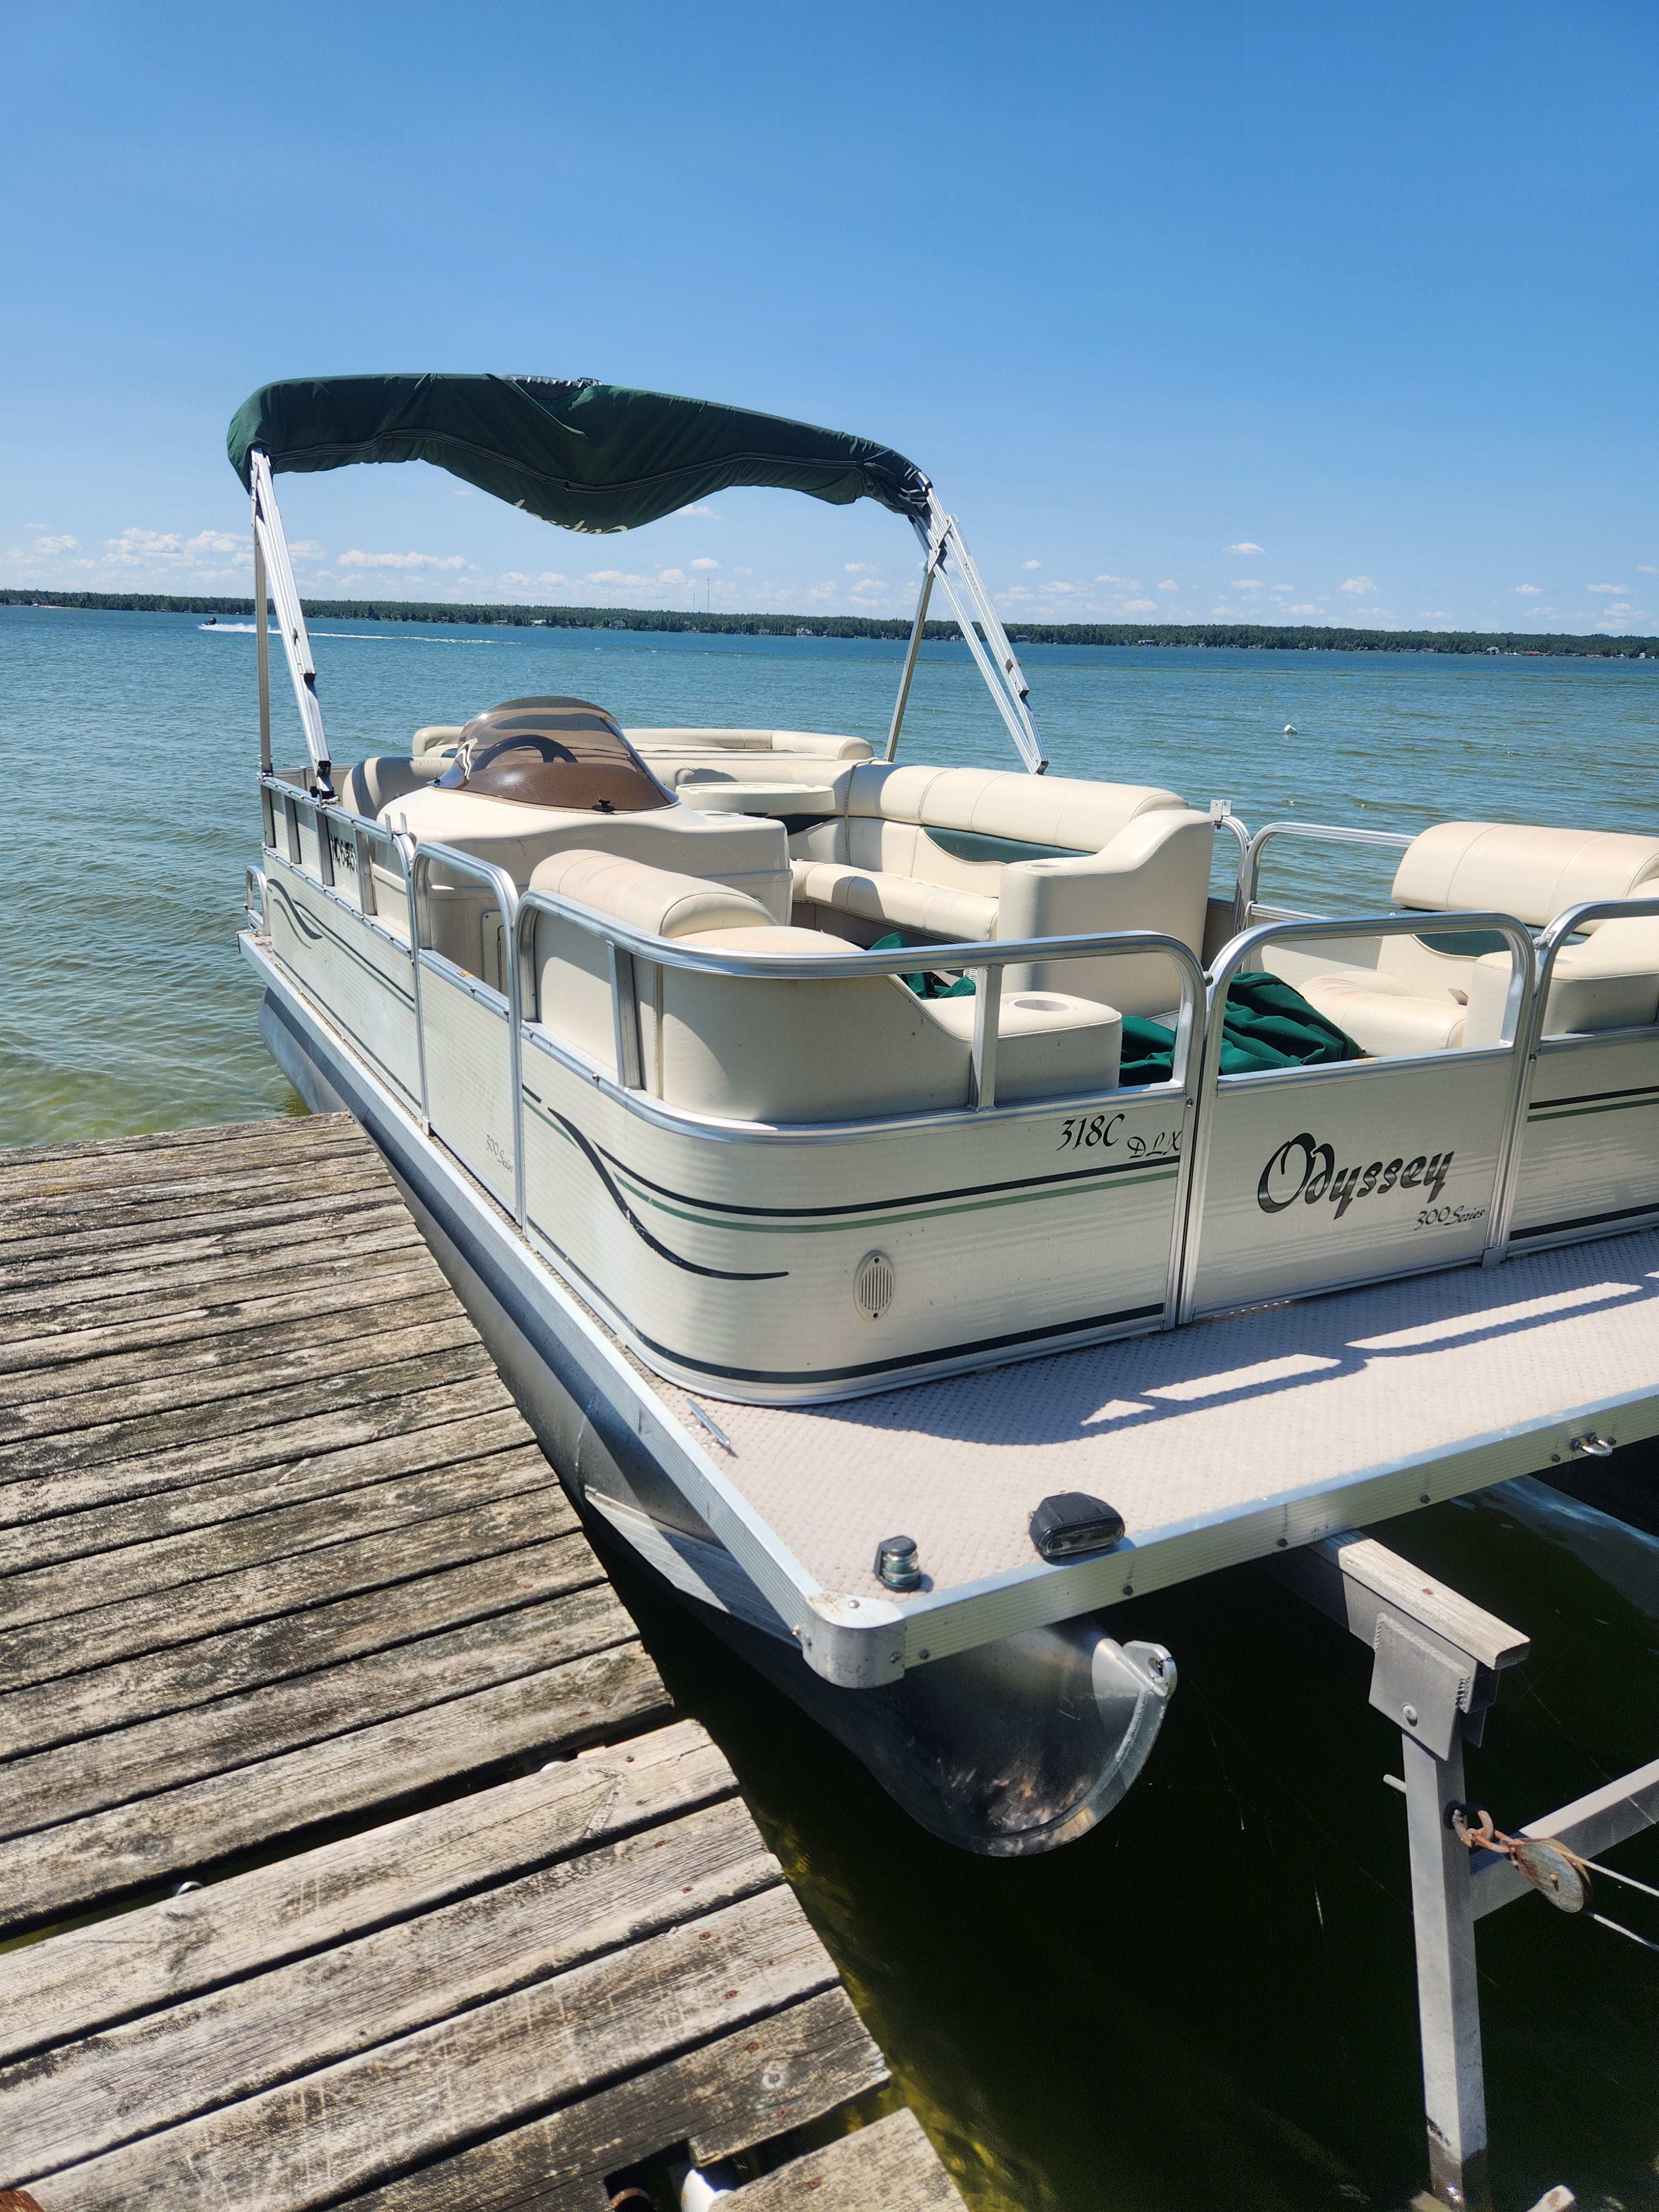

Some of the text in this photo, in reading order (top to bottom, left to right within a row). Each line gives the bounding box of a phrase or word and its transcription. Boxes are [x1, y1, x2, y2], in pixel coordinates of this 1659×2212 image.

[487, 1134, 499, 1156] 300
[1056, 1114, 1182, 1159] 318C DLX
[1258, 1133, 1455, 1220] Odyssey
[1413, 1205, 1485, 1231] 300 Series
